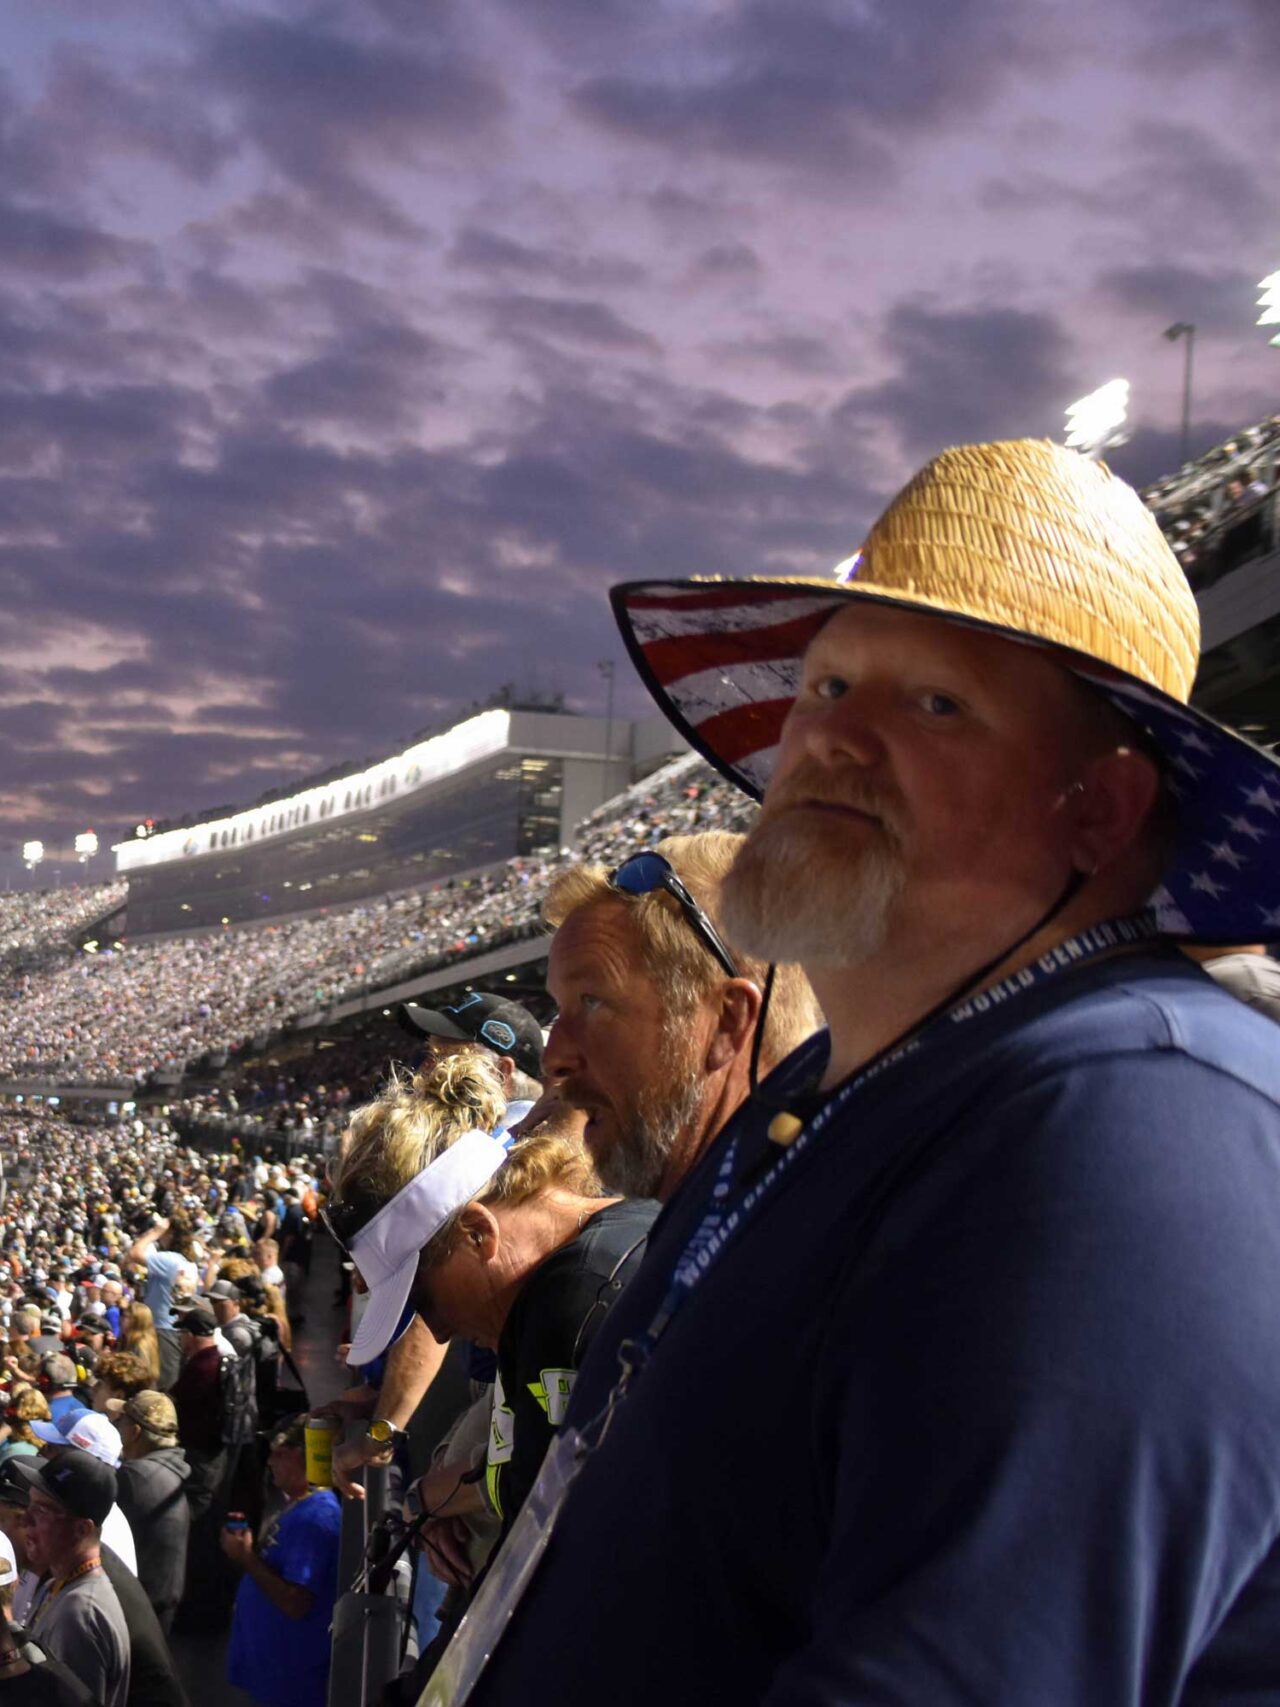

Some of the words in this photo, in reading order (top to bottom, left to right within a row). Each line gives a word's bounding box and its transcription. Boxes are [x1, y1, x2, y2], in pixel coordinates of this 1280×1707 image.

[949, 968, 1036, 1024] WORLD
[1037, 921, 1119, 975] CENTER
[680, 1210, 739, 1288] WORLD
[743, 1133, 808, 1210] CENTER
[811, 1105, 833, 1131] OF
